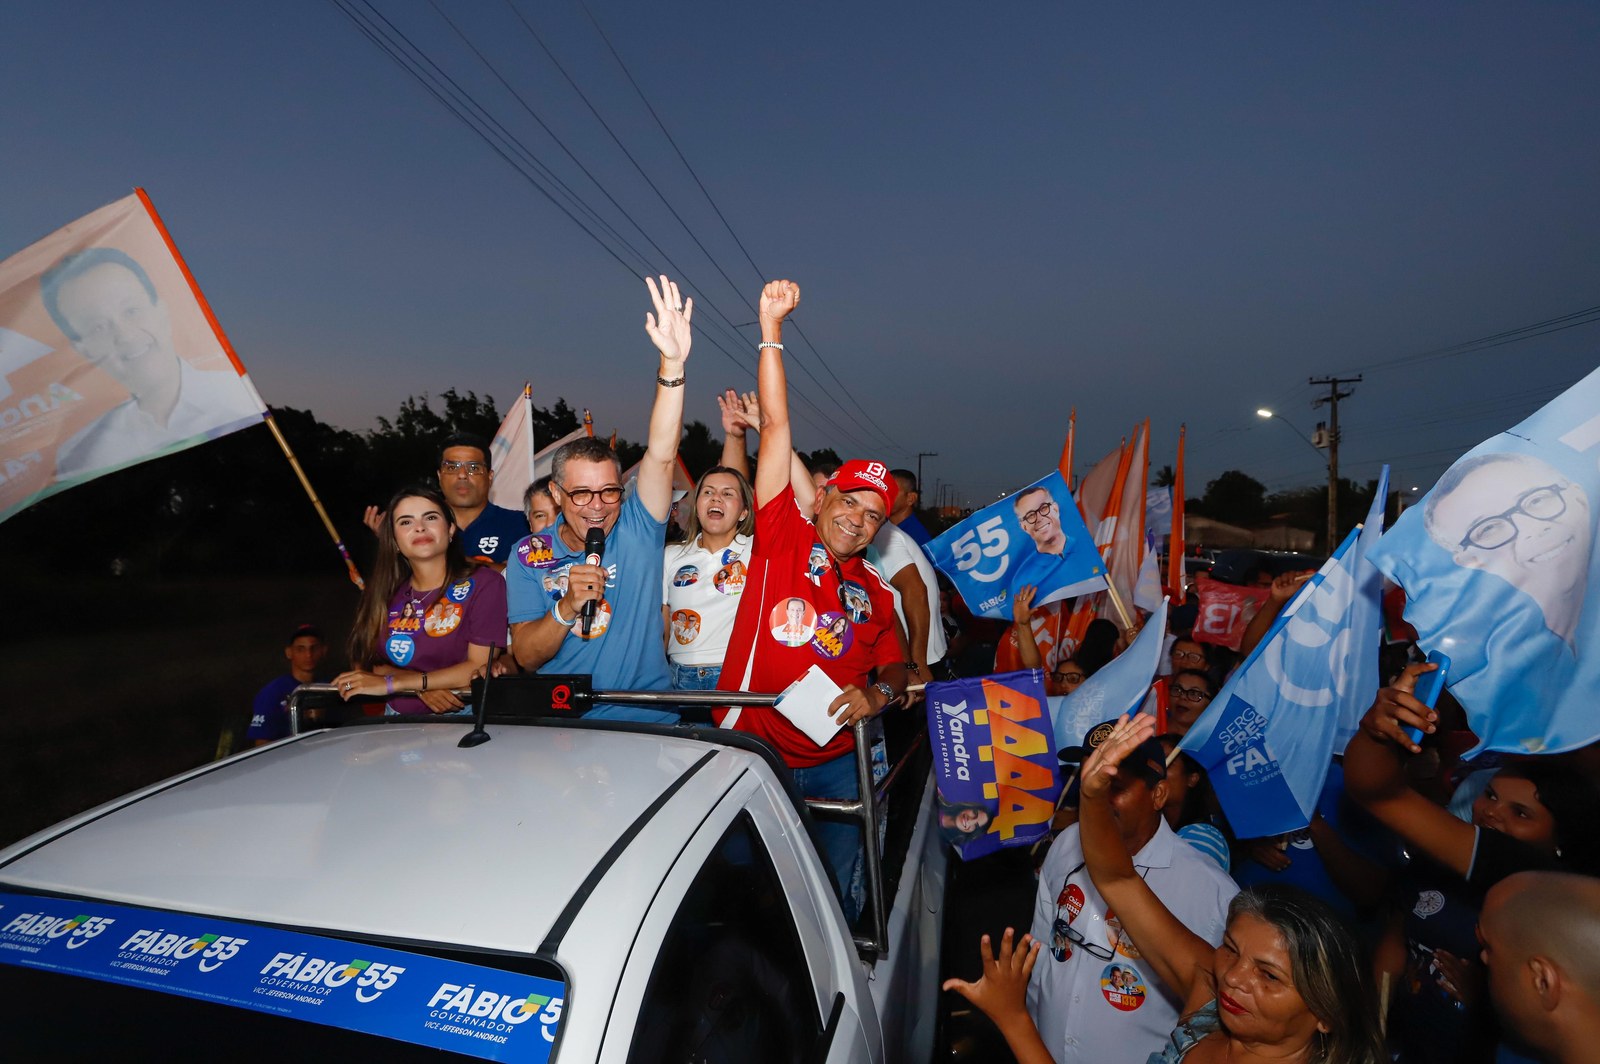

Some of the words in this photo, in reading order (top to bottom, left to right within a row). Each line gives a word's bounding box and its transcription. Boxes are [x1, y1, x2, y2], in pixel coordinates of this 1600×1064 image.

[866, 462, 887, 480] 131
[478, 536, 499, 548] 55
[951, 515, 1010, 571] 55
[453, 586, 470, 597] 55
[389, 639, 412, 654] 55
[933, 701, 944, 740] DEPUTADA
[941, 742, 951, 778] FEDERAL
[941, 699, 971, 782] Yandra
[973, 678, 1055, 841] 4444
[1, 912, 76, 938] FÁBIO
[72, 917, 116, 939] 55
[119, 928, 204, 960] FÁBIO
[203, 936, 250, 961] 55
[109, 960, 121, 968] VICE
[119, 961, 145, 973] JEFERSON
[143, 965, 170, 977] ANDRADE
[117, 951, 179, 967] GOVERNADOR
[260, 952, 356, 988] FÁBIO
[356, 962, 407, 990] 55
[253, 986, 267, 995] VICE
[265, 989, 296, 1002] JEFERSON
[294, 995, 325, 1006] ANDRADE
[260, 976, 332, 996] GOVERNADOR
[426, 982, 537, 1025] FÁBIO
[424, 1020, 440, 1030] VICE
[439, 1024, 475, 1038] JEFERSON
[473, 1031, 508, 1044] ANDRADE
[430, 1009, 514, 1034] GOVERNADOR
